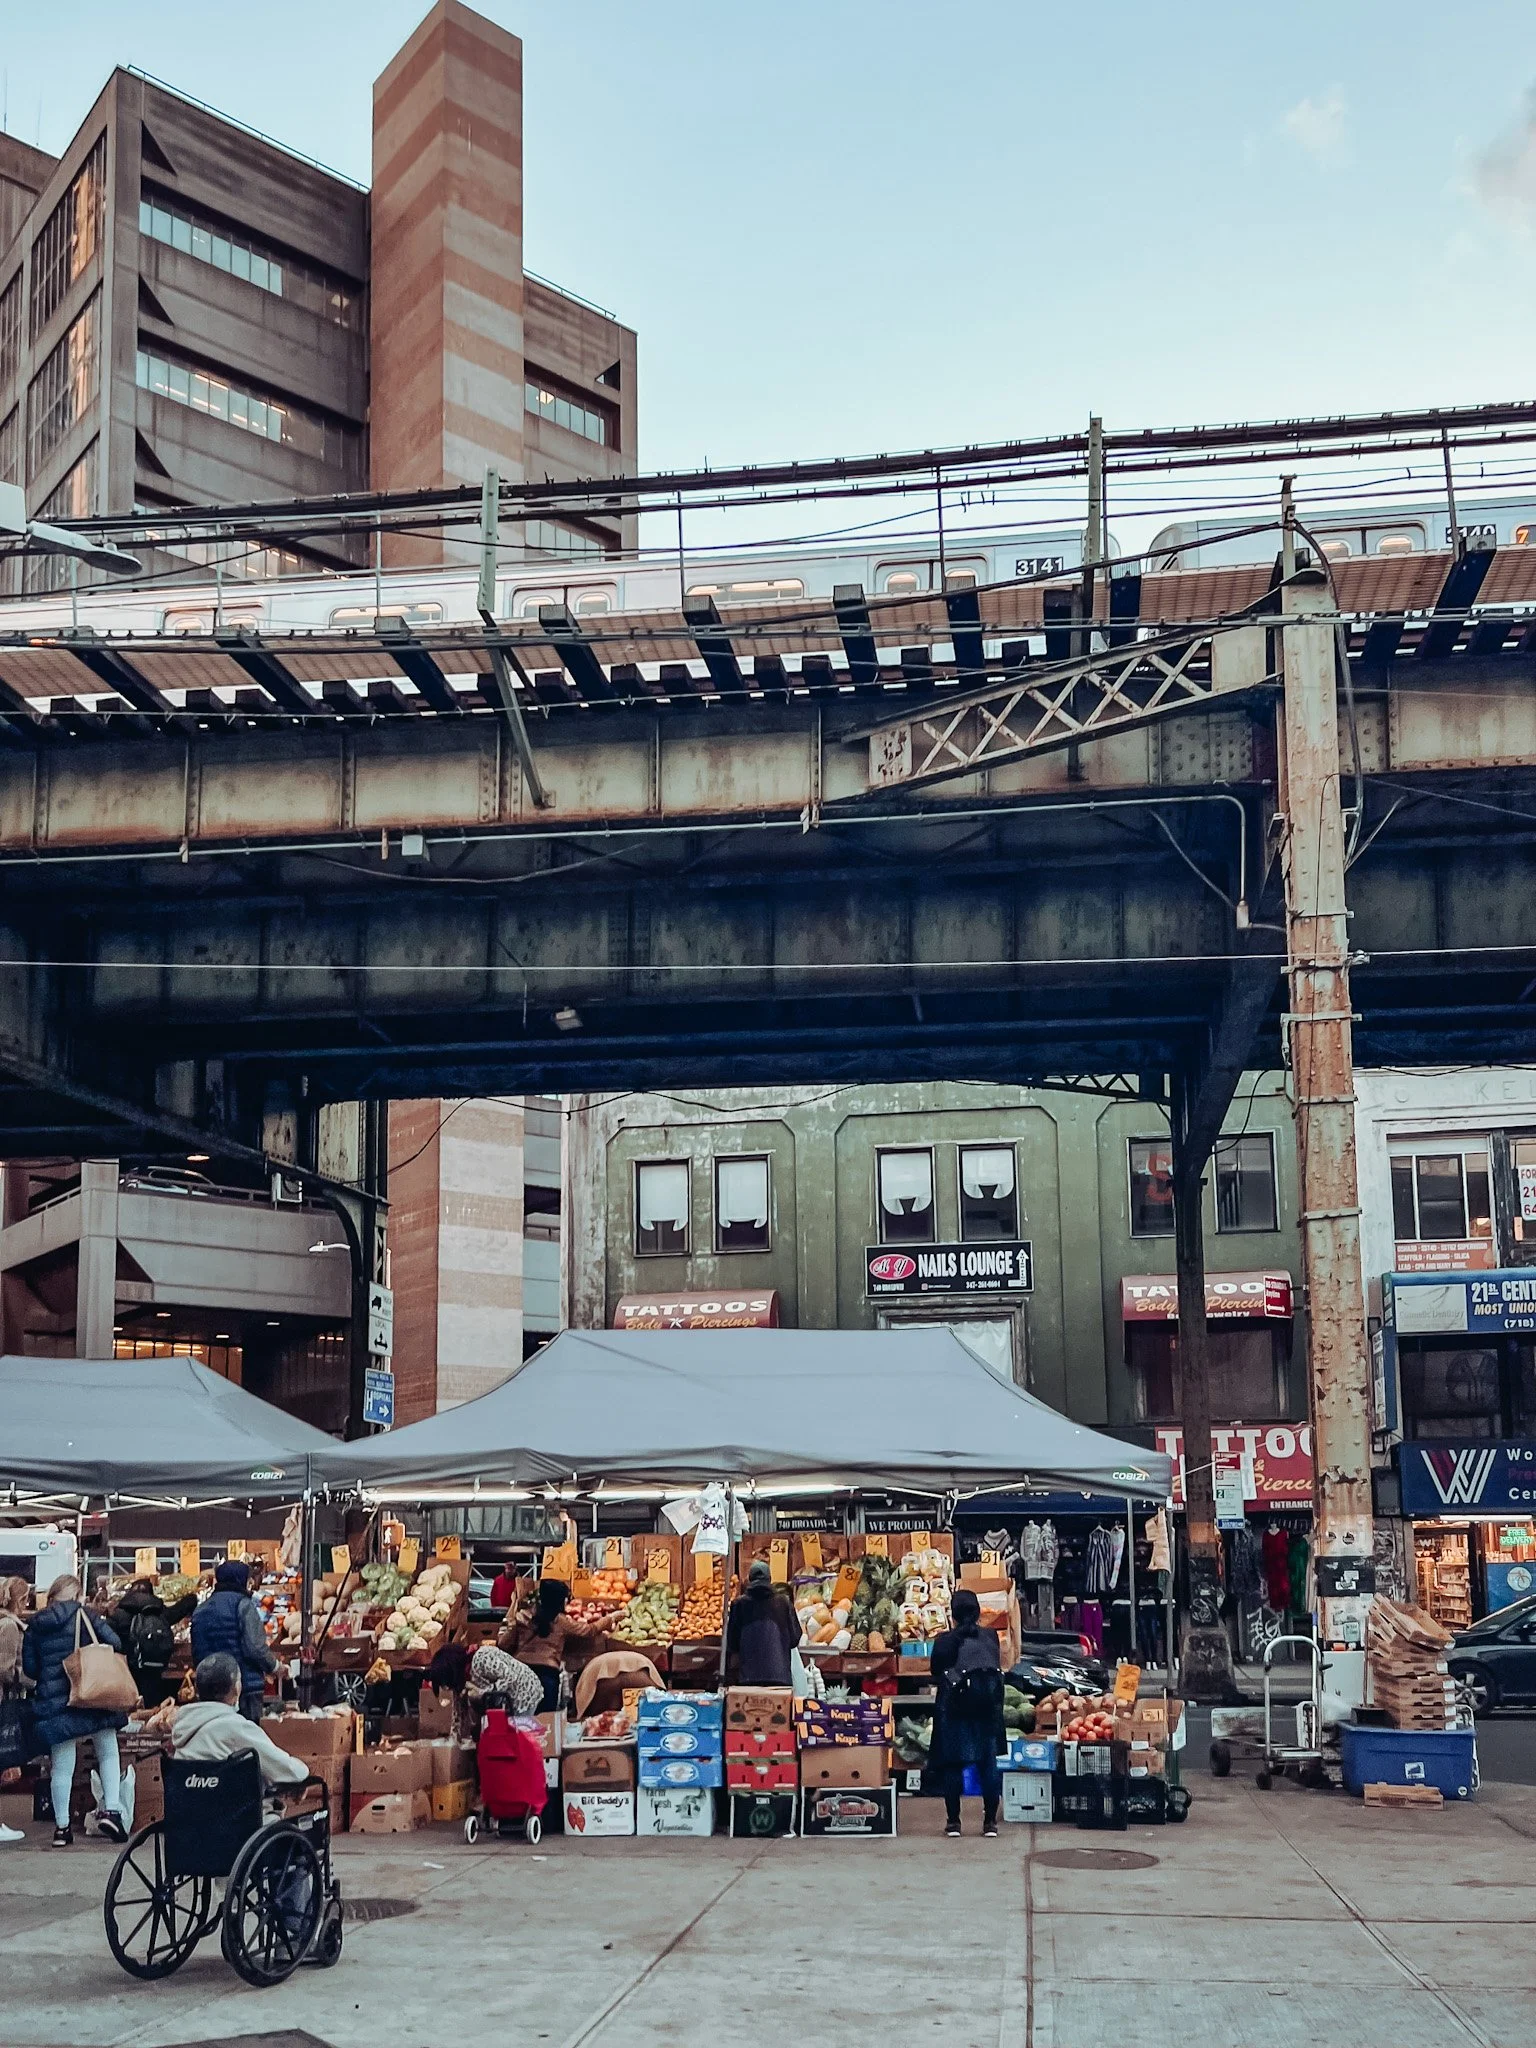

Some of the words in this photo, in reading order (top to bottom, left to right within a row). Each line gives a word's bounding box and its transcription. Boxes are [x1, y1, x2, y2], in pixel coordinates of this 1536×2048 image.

[1016, 558, 1063, 575] 3141
[917, 1253, 957, 1278] NAILS
[960, 1250, 1013, 1277] LOUNGE
[621, 1300, 768, 1317] TATTOOS
[1135, 1299, 1177, 1313] Body
[1474, 1303, 1503, 1316] MOST
[1509, 1301, 1536, 1314] UNIO
[624, 1316, 662, 1330] Body
[690, 1315, 758, 1329] Piercings
[1504, 1318, 1534, 1329] (718)
[1158, 1428, 1312, 1460] TTTO
[251, 1472, 283, 1480] COBIZI
[1113, 1471, 1147, 1481] COBIZI
[868, 1521, 885, 1531] WE
[887, 1520, 933, 1531] PROUDLY
[831, 1709, 855, 1721] Kapi
[835, 1733, 859, 1746] Kapi
[185, 1774, 219, 1789] drive
